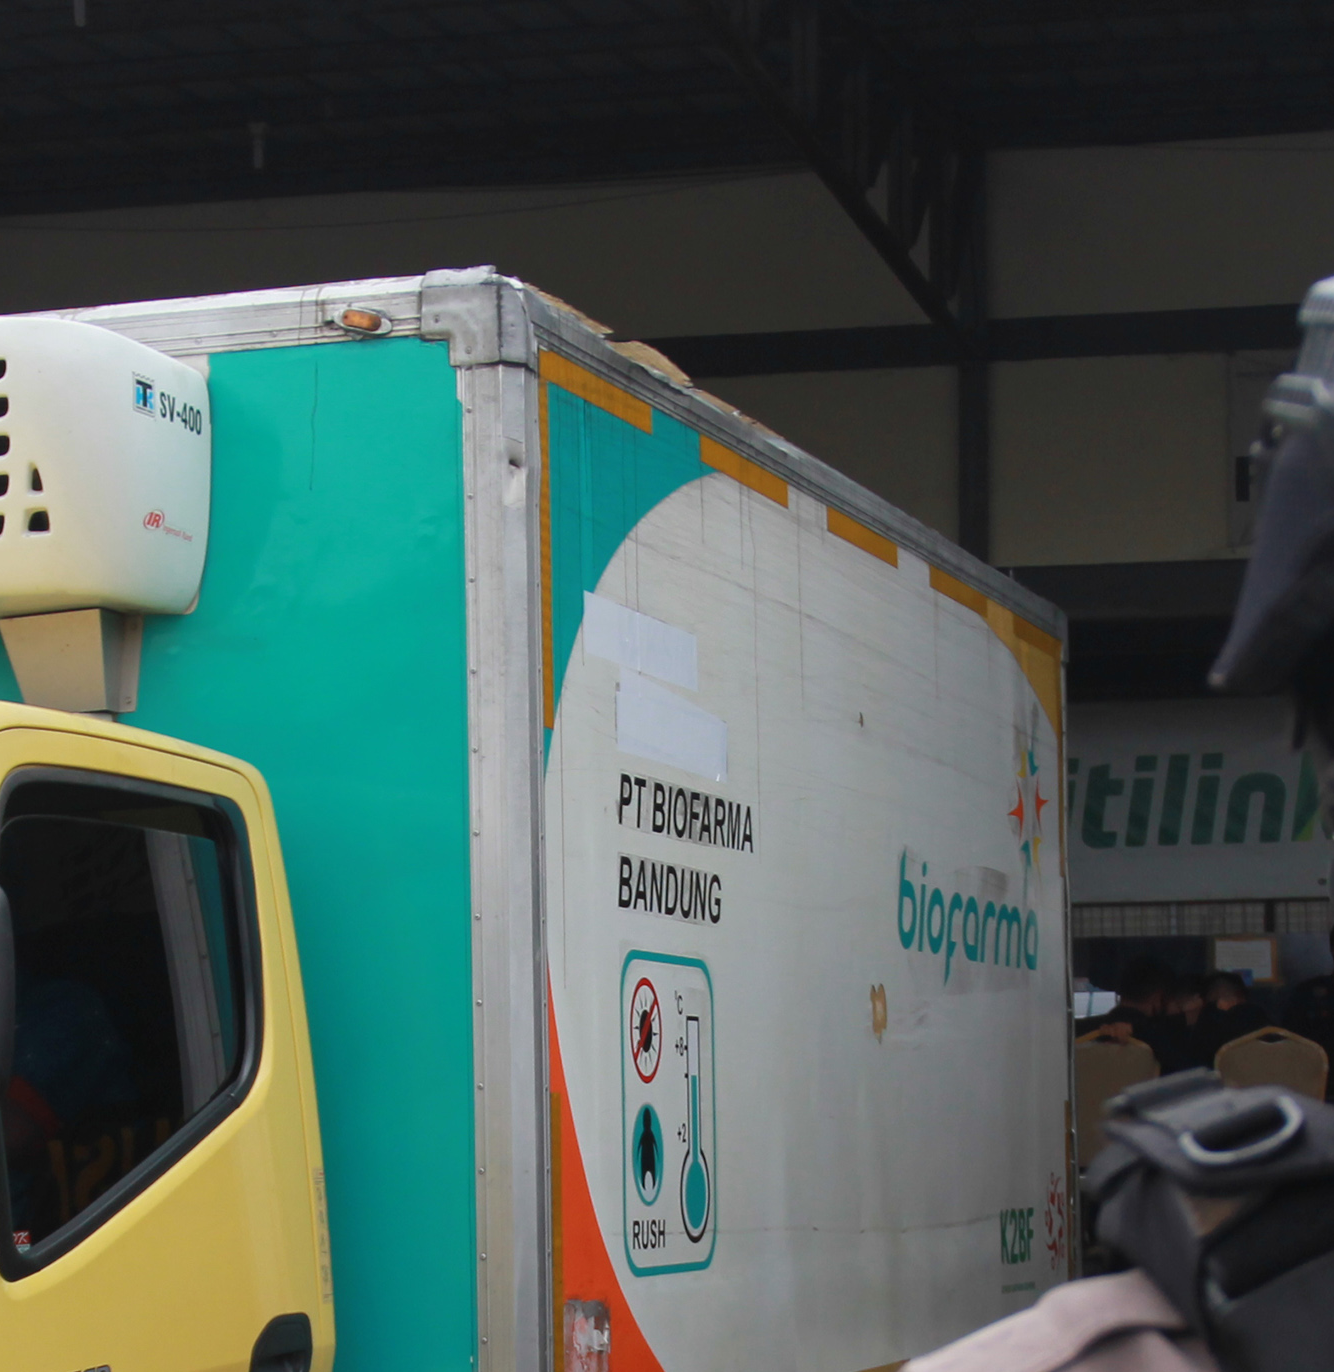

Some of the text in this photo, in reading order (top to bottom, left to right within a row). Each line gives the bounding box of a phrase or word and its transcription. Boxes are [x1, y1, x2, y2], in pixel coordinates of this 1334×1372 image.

[159, 391, 202, 436] SV-400
[618, 773, 754, 853] PT BIOFARMA
[618, 856, 722, 924] BANDUNG
[897, 846, 1039, 987] biofarma
[633, 1218, 666, 1250] RUSH
